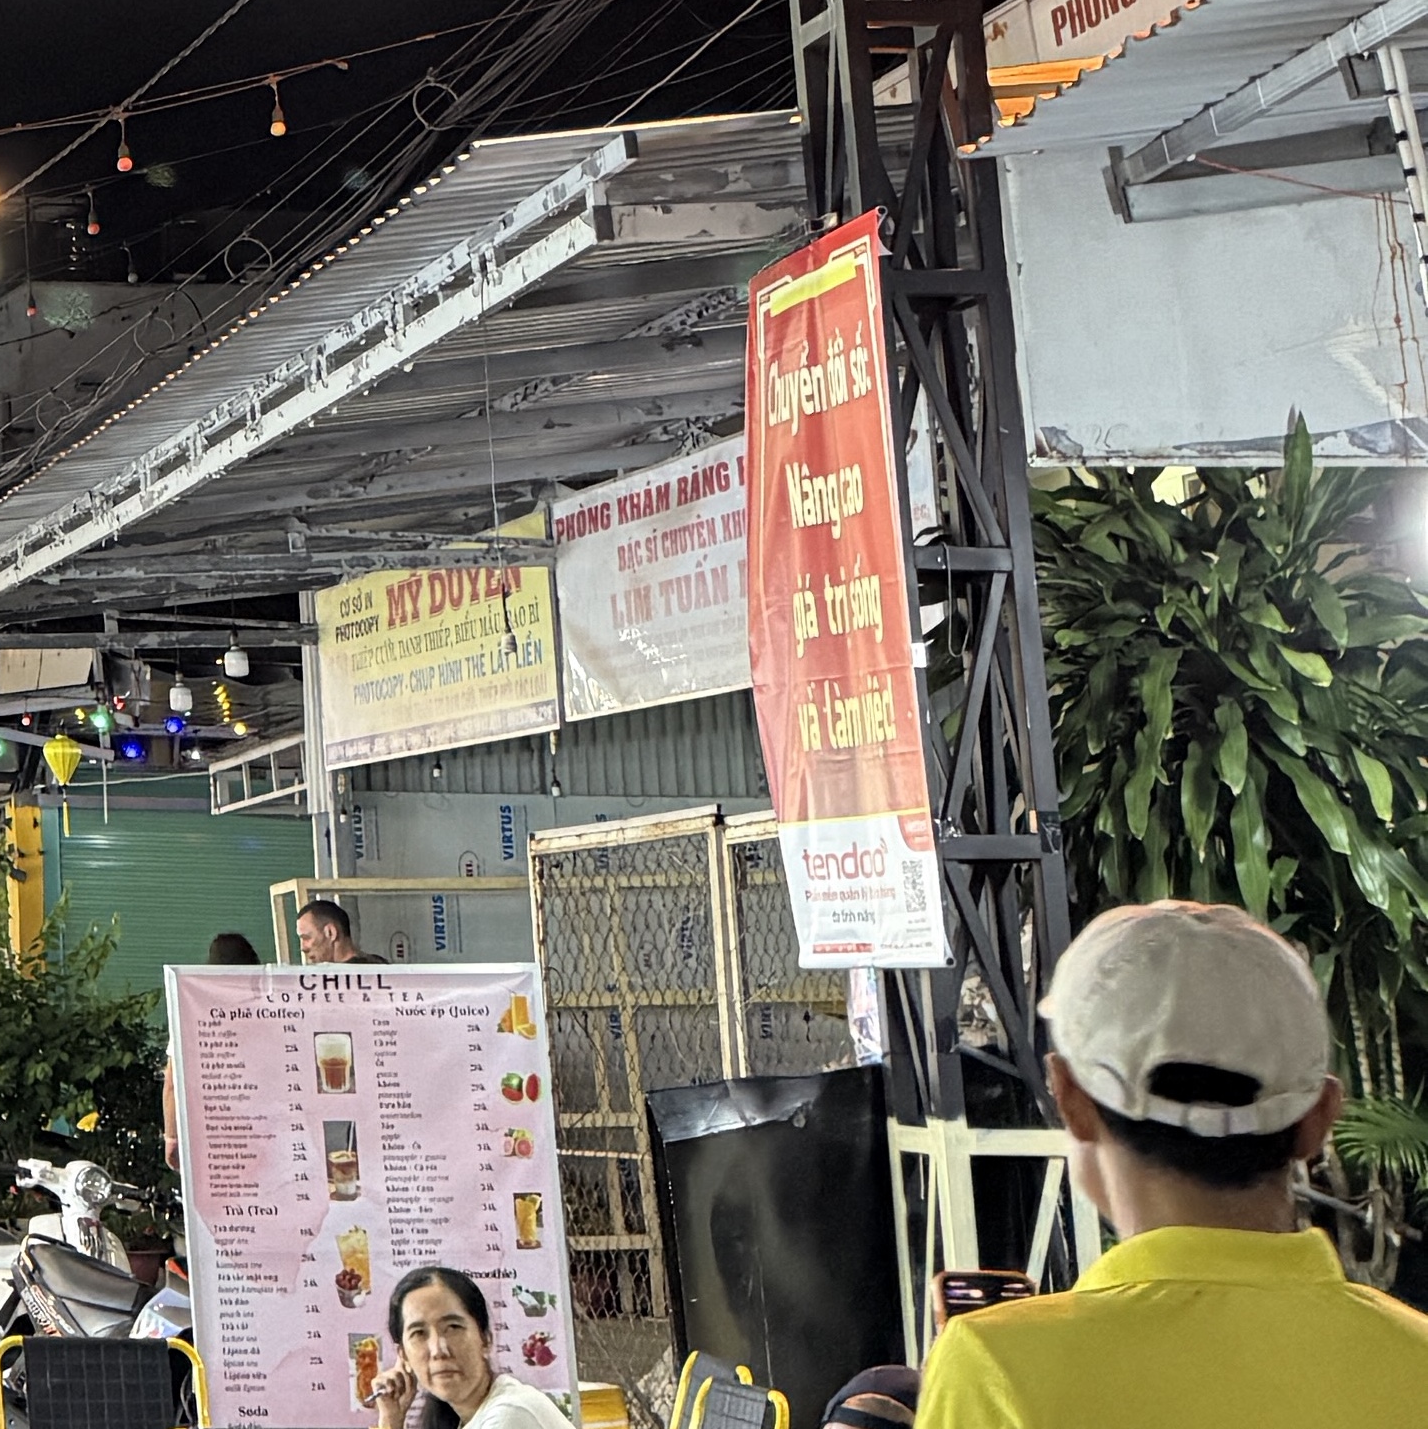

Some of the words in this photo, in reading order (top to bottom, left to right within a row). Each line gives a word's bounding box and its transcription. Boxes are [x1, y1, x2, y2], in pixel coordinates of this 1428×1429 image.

[555, 502, 611, 546] PHÒNG
[616, 479, 670, 525] KHÁM
[677, 461, 730, 507] RĂNG
[785, 462, 842, 540] Nâng
[842, 462, 864, 517] cao
[335, 615, 380, 644] PHOTOCOPY
[793, 573, 819, 659] giá
[500, 804, 515, 861] VIRTUS
[802, 839, 886, 881] tendoo
[432, 894, 446, 951] VIRTUS
[300, 974, 392, 991] CHILL
[388, 992, 424, 1002] TEA
[210, 1008, 226, 1019] Cà
[257, 1008, 305, 1020] (Coffee)
[449, 1005, 490, 1019] (Juice)
[248, 1205, 278, 1217] (Tea)
[238, 1406, 269, 1417] Soda
